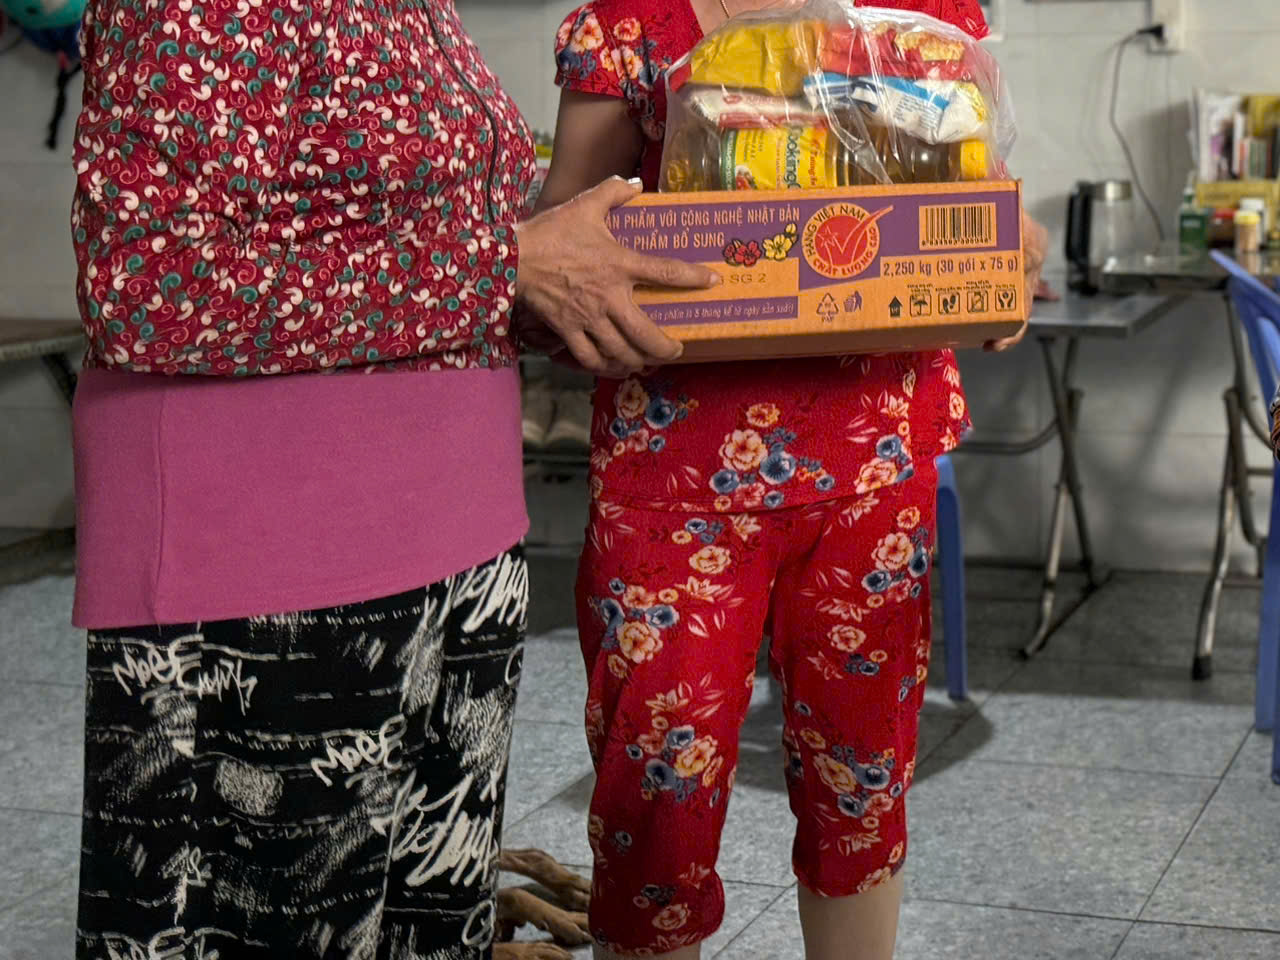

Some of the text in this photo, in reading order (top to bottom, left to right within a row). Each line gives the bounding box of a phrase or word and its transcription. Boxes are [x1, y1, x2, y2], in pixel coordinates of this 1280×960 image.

[624, 208, 656, 229] PHẨM
[659, 210, 677, 228] VỚI
[681, 210, 709, 227] CÔNG
[714, 207, 743, 227] NGHỆ
[747, 205, 775, 226] NHẬT
[779, 204, 800, 222] BẢN
[840, 204, 866, 221] NAM
[633, 229, 668, 251] PHẨM
[673, 228, 690, 249] BỔ
[693, 231, 725, 248] SUNG
[883, 261, 915, 277] 2,250
[919, 260, 932, 276] kg
[936, 259, 954, 277] (30
[958, 258, 976, 274] gói
[980, 261, 987, 271] x
[1007, 256, 1019, 273] g)
